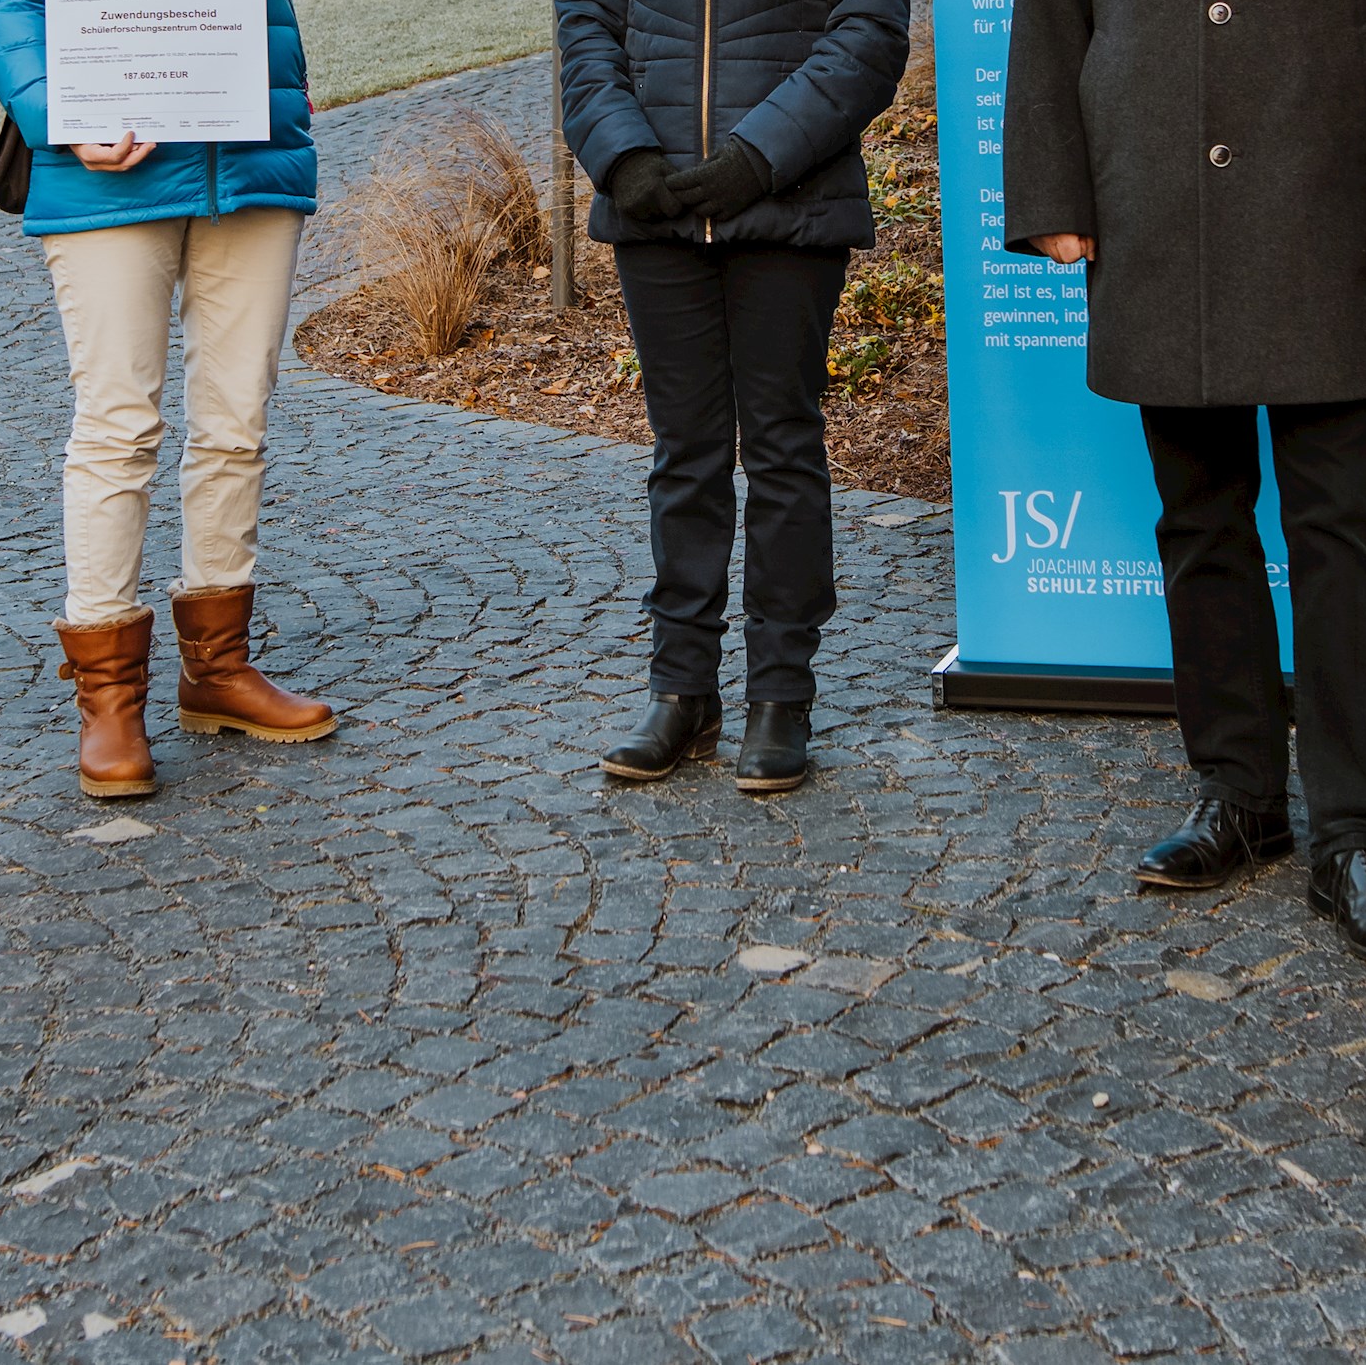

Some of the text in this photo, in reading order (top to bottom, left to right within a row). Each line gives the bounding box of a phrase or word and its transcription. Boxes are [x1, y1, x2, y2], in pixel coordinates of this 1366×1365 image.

[100, 9, 217, 21] Zuwendungsbescheid
[81, 23, 242, 35] Schülerforschungszentrum Odenwald
[973, 18, 995, 34] für
[123, 71, 189, 80] 187.602,76 EUR
[975, 68, 1002, 82] Der
[976, 93, 1002, 107] seit
[977, 117, 995, 131] ist
[980, 188, 1005, 203] Die
[981, 213, 1006, 227] Fac
[981, 236, 1002, 251] Ab
[982, 260, 1043, 275] Formate
[983, 285, 1009, 299] Ziel
[1014, 284, 1031, 299] ist
[1036, 287, 1057, 301] es,
[983, 308, 1088, 326] gewinnen, ind
[984, 332, 1087, 351] mit spannend
[1027, 558, 1096, 575] JOACHIM
[1101, 560, 1113, 576] &
[1027, 577, 1097, 595] SCHULZ
